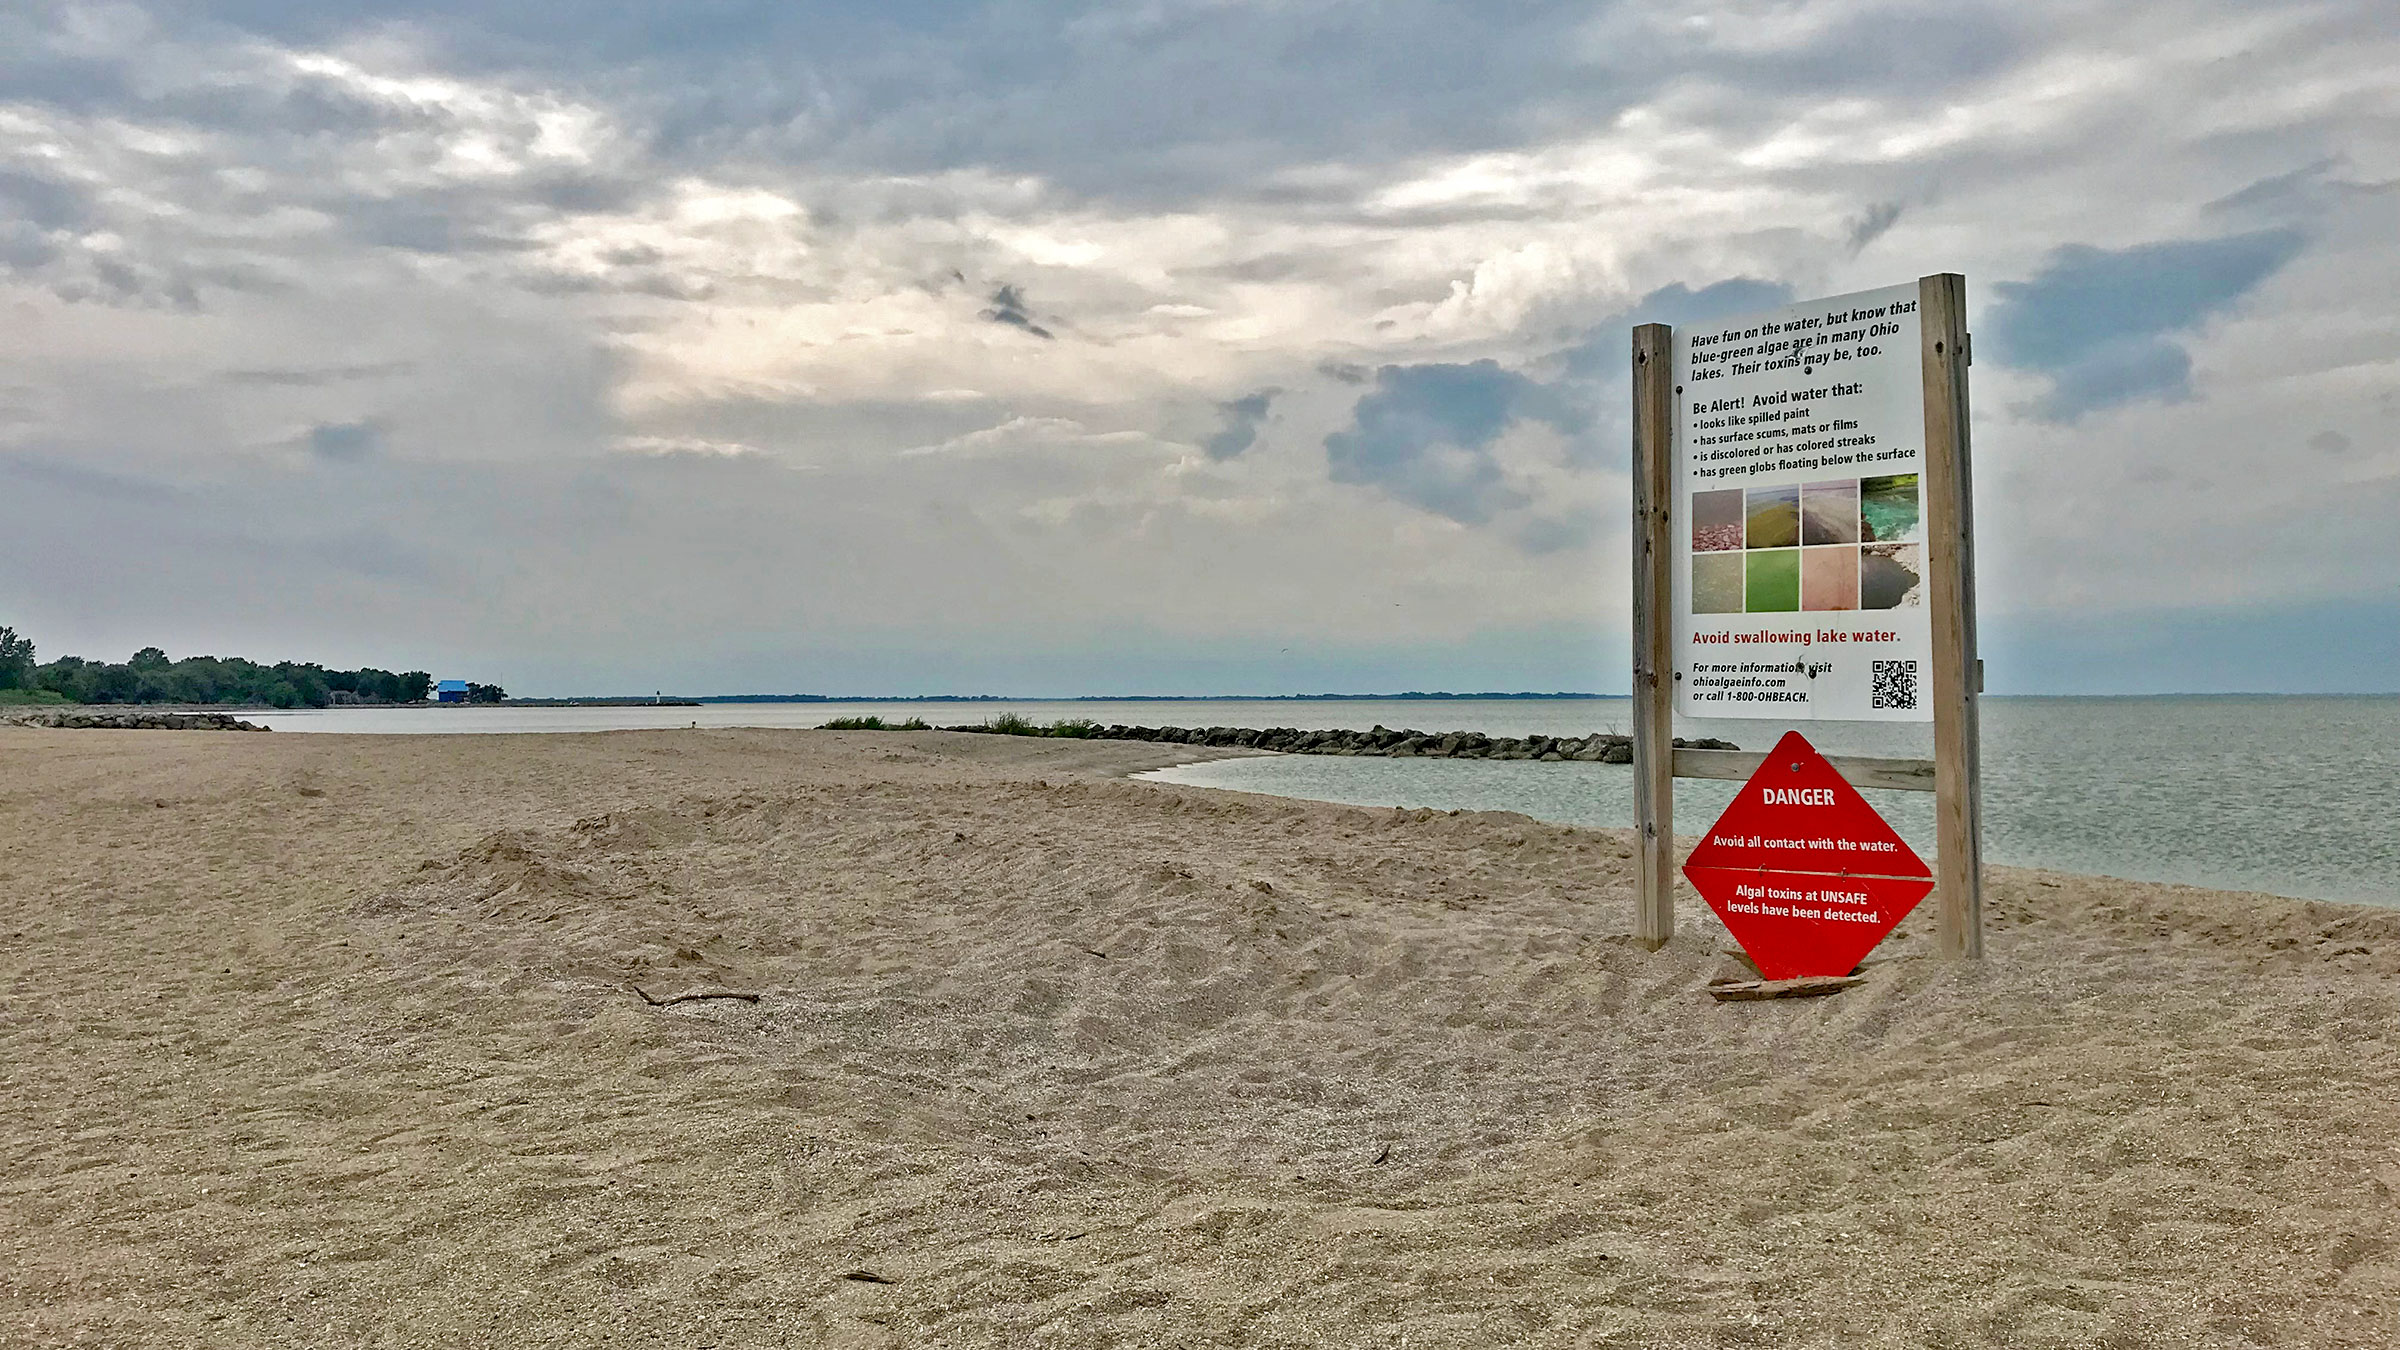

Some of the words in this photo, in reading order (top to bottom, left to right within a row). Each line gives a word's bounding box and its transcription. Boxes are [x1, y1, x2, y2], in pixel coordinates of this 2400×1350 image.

[1691, 334, 1719, 347] Have
[1722, 330, 1741, 343] fun
[1744, 328, 1758, 339] on
[1762, 322, 1780, 335] the
[1784, 316, 1822, 332] water,
[1826, 312, 1848, 326] but
[1851, 307, 1886, 322] know
[1890, 300, 1916, 315] that
[1691, 346, 1754, 366] blue-green
[1757, 340, 1789, 358] algae
[1793, 338, 1812, 349] are
[1816, 334, 1828, 346] in
[1831, 328, 1867, 344] many
[1870, 323, 1899, 337] Ohio
[1691, 368, 1725, 382] lakes.
[1732, 361, 1762, 376] Their
[1764, 357, 1800, 371] toxins
[1803, 353, 1830, 368] may
[1833, 348, 1853, 362] be,
[1857, 345, 1882, 357] too.
[1693, 403, 1707, 414] Be
[1711, 397, 1745, 412] Alert!
[1753, 391, 1787, 407] Avoid
[1791, 387, 1828, 401] water
[1832, 382, 1863, 397] that:
[1700, 419, 1725, 430] looks
[1728, 416, 1746, 427] like
[1748, 411, 1781, 425] spilled
[1784, 408, 1810, 422] paint
[1700, 435, 1716, 446] has
[1719, 431, 1754, 444] surface
[1756, 429, 1789, 440] scums,
[1791, 425, 1816, 435] mats
[1819, 423, 1830, 432] or
[1833, 419, 1858, 431] films
[1700, 452, 1708, 461] is
[1711, 446, 1760, 460] discolored
[1763, 446, 1774, 455] or
[1777, 442, 1793, 453] has
[1797, 438, 1834, 452] colored
[1837, 434, 1876, 447] streaks
[1700, 466, 1717, 477] has
[1719, 465, 1747, 478] green
[1750, 461, 1776, 475] globs
[1779, 456, 1818, 470] floating
[1821, 453, 1853, 466] below
[1856, 451, 1873, 462] the
[1876, 447, 1916, 461] surface
[1693, 631, 1730, 644] Avoid
[1734, 630, 1811, 646] swallowing
[1817, 629, 1847, 642] lake
[1853, 630, 1901, 642] water.
[1693, 663, 1711, 673] For
[1714, 663, 1737, 673] more
[1809, 663, 1832, 673] visit
[1693, 677, 1786, 690] ohioalgaeinfo.com
[1693, 693, 1704, 701] or
[1706, 691, 1724, 701] call
[1727, 692, 1809, 702] 1-800-OHBEACH.
[1763, 788, 1835, 805] DANGER
[1713, 835, 1744, 847] Avoid
[1747, 836, 1761, 848] all
[1764, 838, 1806, 849] contact
[1808, 838, 1834, 850] with
[1837, 839, 1856, 851] the
[1859, 840, 1898, 852] water.
[1736, 885, 1764, 899] Algal
[1768, 887, 1802, 900] toxins
[1806, 890, 1818, 901] at
[1821, 891, 1867, 905] UNSAFE
[1727, 900, 1759, 914] levels
[1762, 903, 1789, 916] have
[1792, 905, 1821, 919] been
[1824, 908, 1880, 923] detected.
